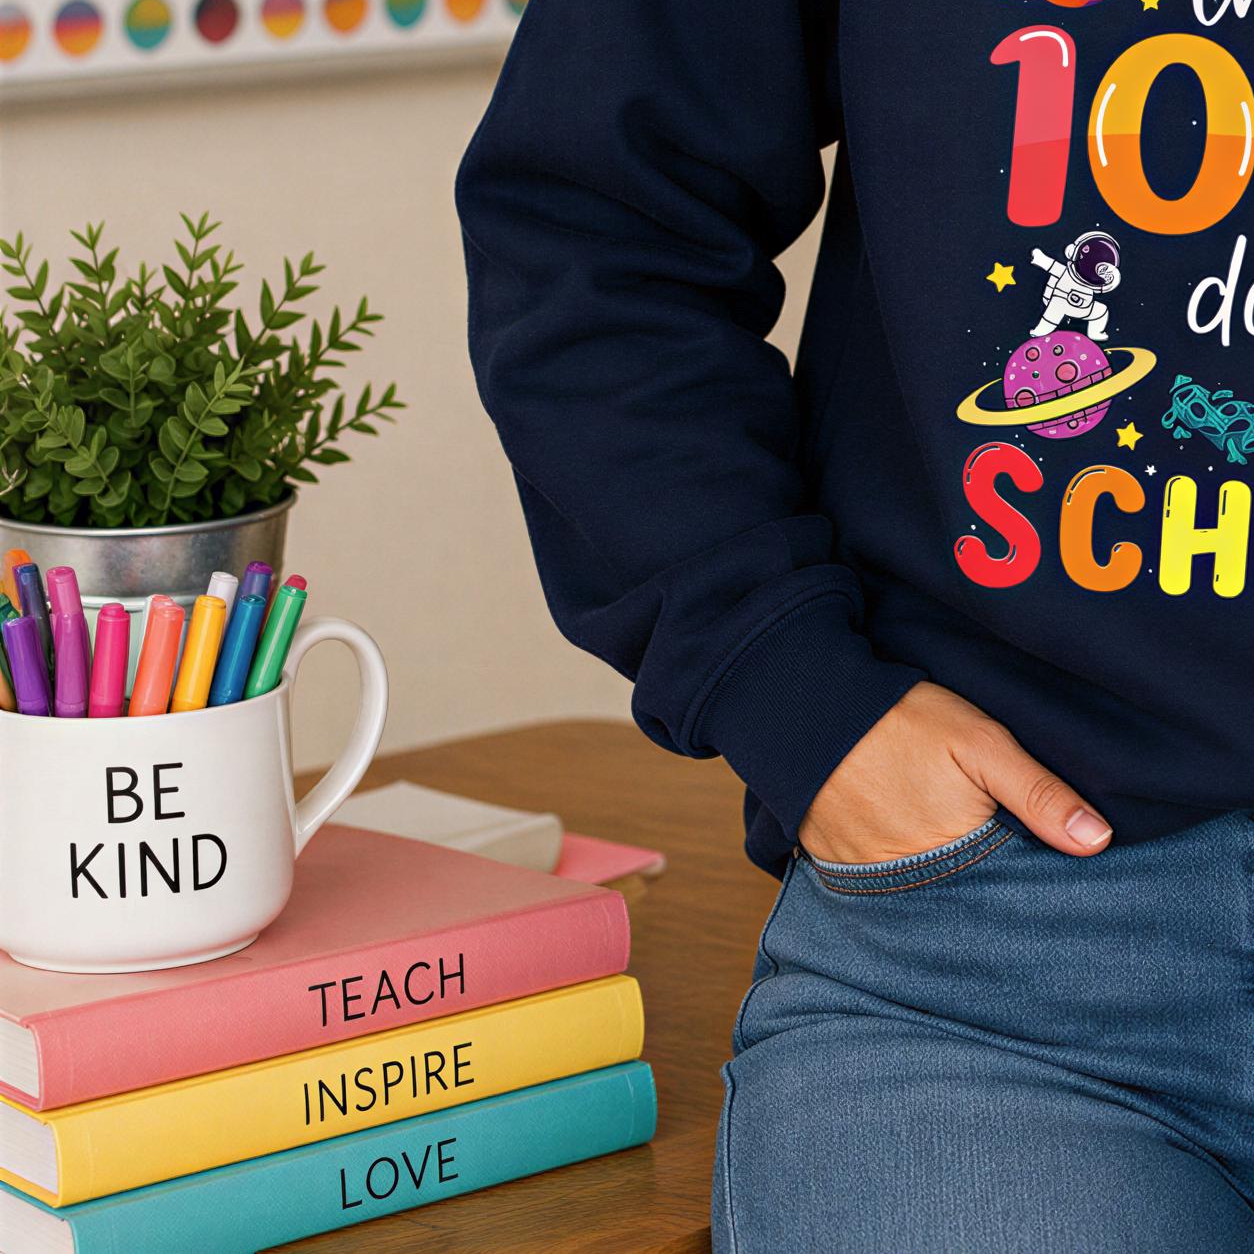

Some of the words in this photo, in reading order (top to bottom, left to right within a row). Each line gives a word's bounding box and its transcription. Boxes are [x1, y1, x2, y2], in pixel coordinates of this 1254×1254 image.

[103, 762, 187, 825] BE
[68, 832, 229, 901] KIND
[307, 952, 467, 1028] TEACH
[303, 1041, 475, 1127] INSPIRE
[339, 1137, 460, 1211] LOVE
